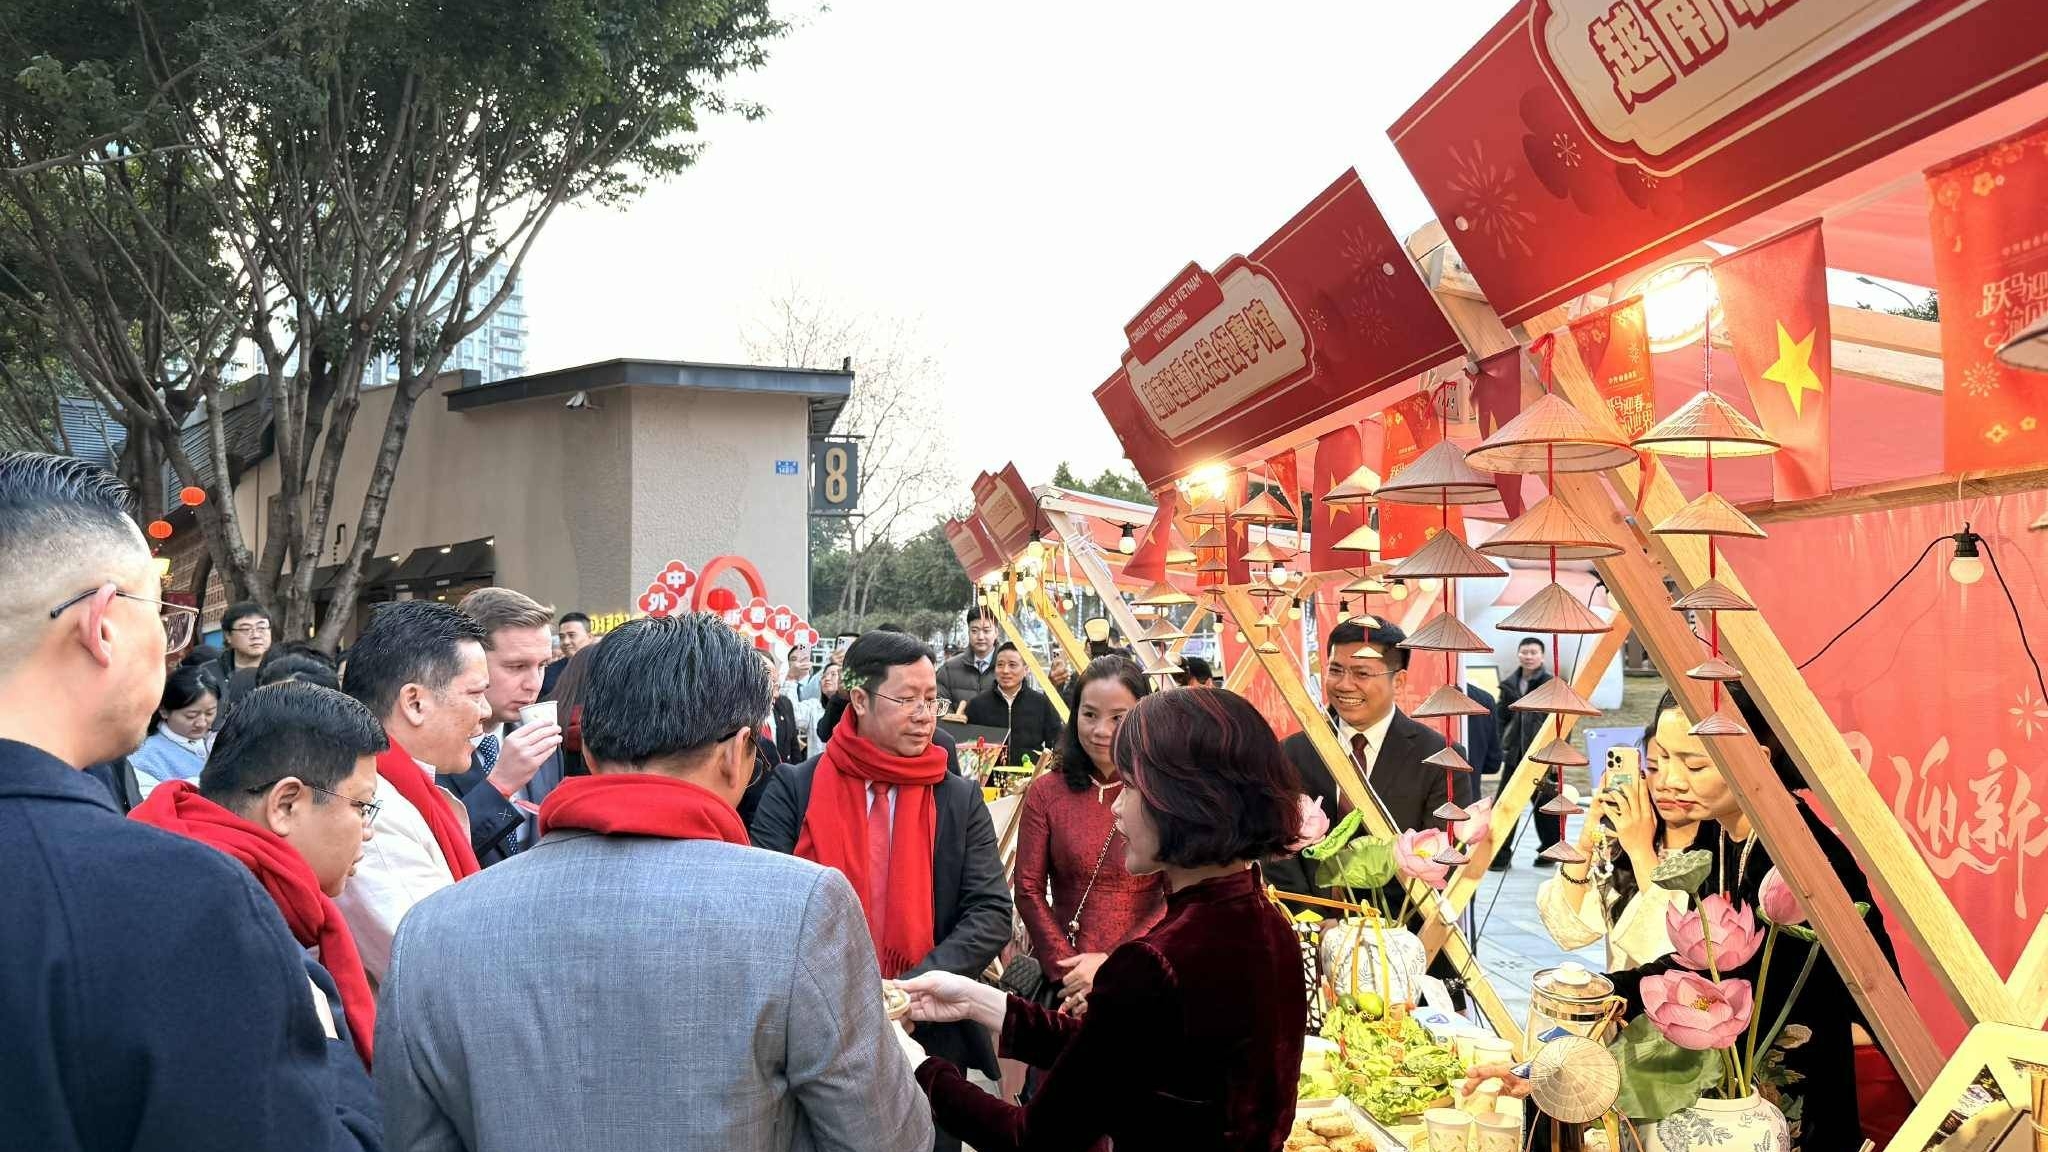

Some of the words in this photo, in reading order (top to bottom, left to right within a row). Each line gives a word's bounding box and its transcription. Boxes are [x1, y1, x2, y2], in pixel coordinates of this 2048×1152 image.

[1149, 301, 1173, 325] GENERAL
[1174, 272, 1203, 302] VIETNAM
[1139, 298, 1288, 422] 越南驻重庆总领事馆
[825, 447, 848, 504] 8
[1840, 731, 2048, 920] 迎新
